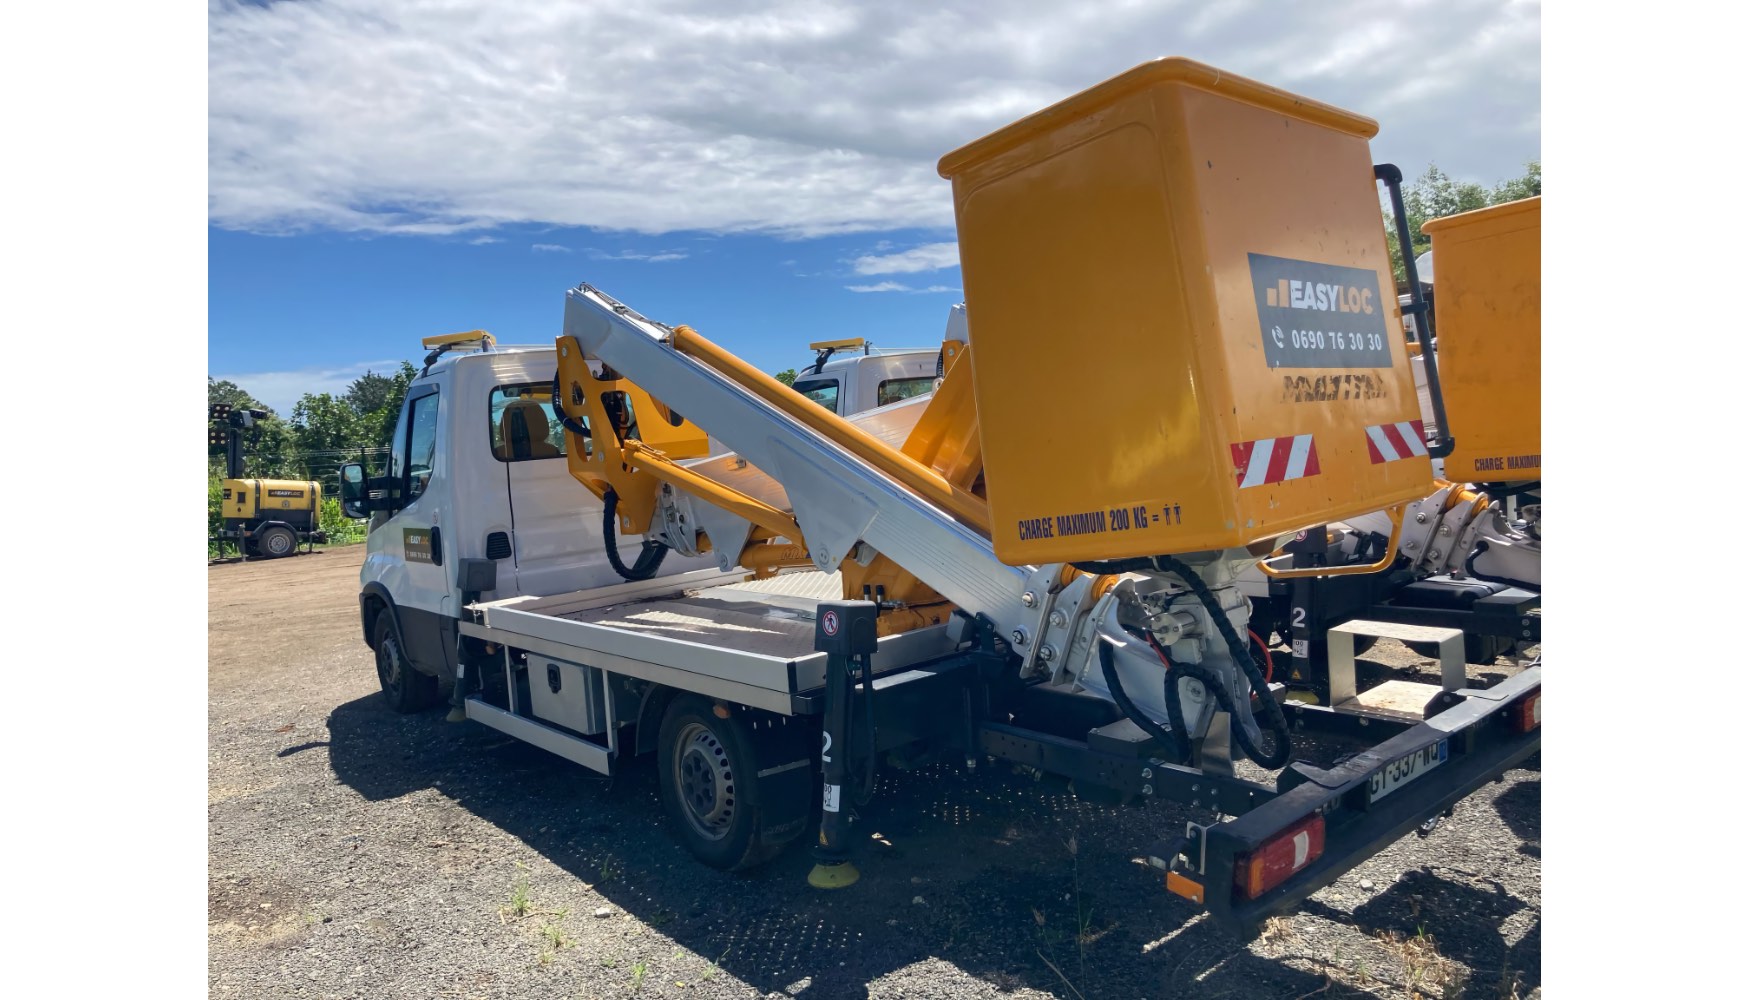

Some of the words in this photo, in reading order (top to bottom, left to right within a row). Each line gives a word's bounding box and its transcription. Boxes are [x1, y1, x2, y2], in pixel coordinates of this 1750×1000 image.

[1290, 279, 1373, 315] EASYLOC
[1292, 329, 1325, 350] 0690
[1328, 331, 1345, 350] 76
[1348, 332, 1364, 351] 30
[1368, 333, 1382, 351] 30
[1474, 456, 1504, 472] CHARGE
[1018, 517, 1054, 541] CHARGE
[1056, 511, 1107, 537] MAXIMUM
[1109, 508, 1130, 532] 200
[1133, 506, 1148, 529] KG
[1292, 606, 1306, 628] 2
[822, 730, 832, 763] 2
